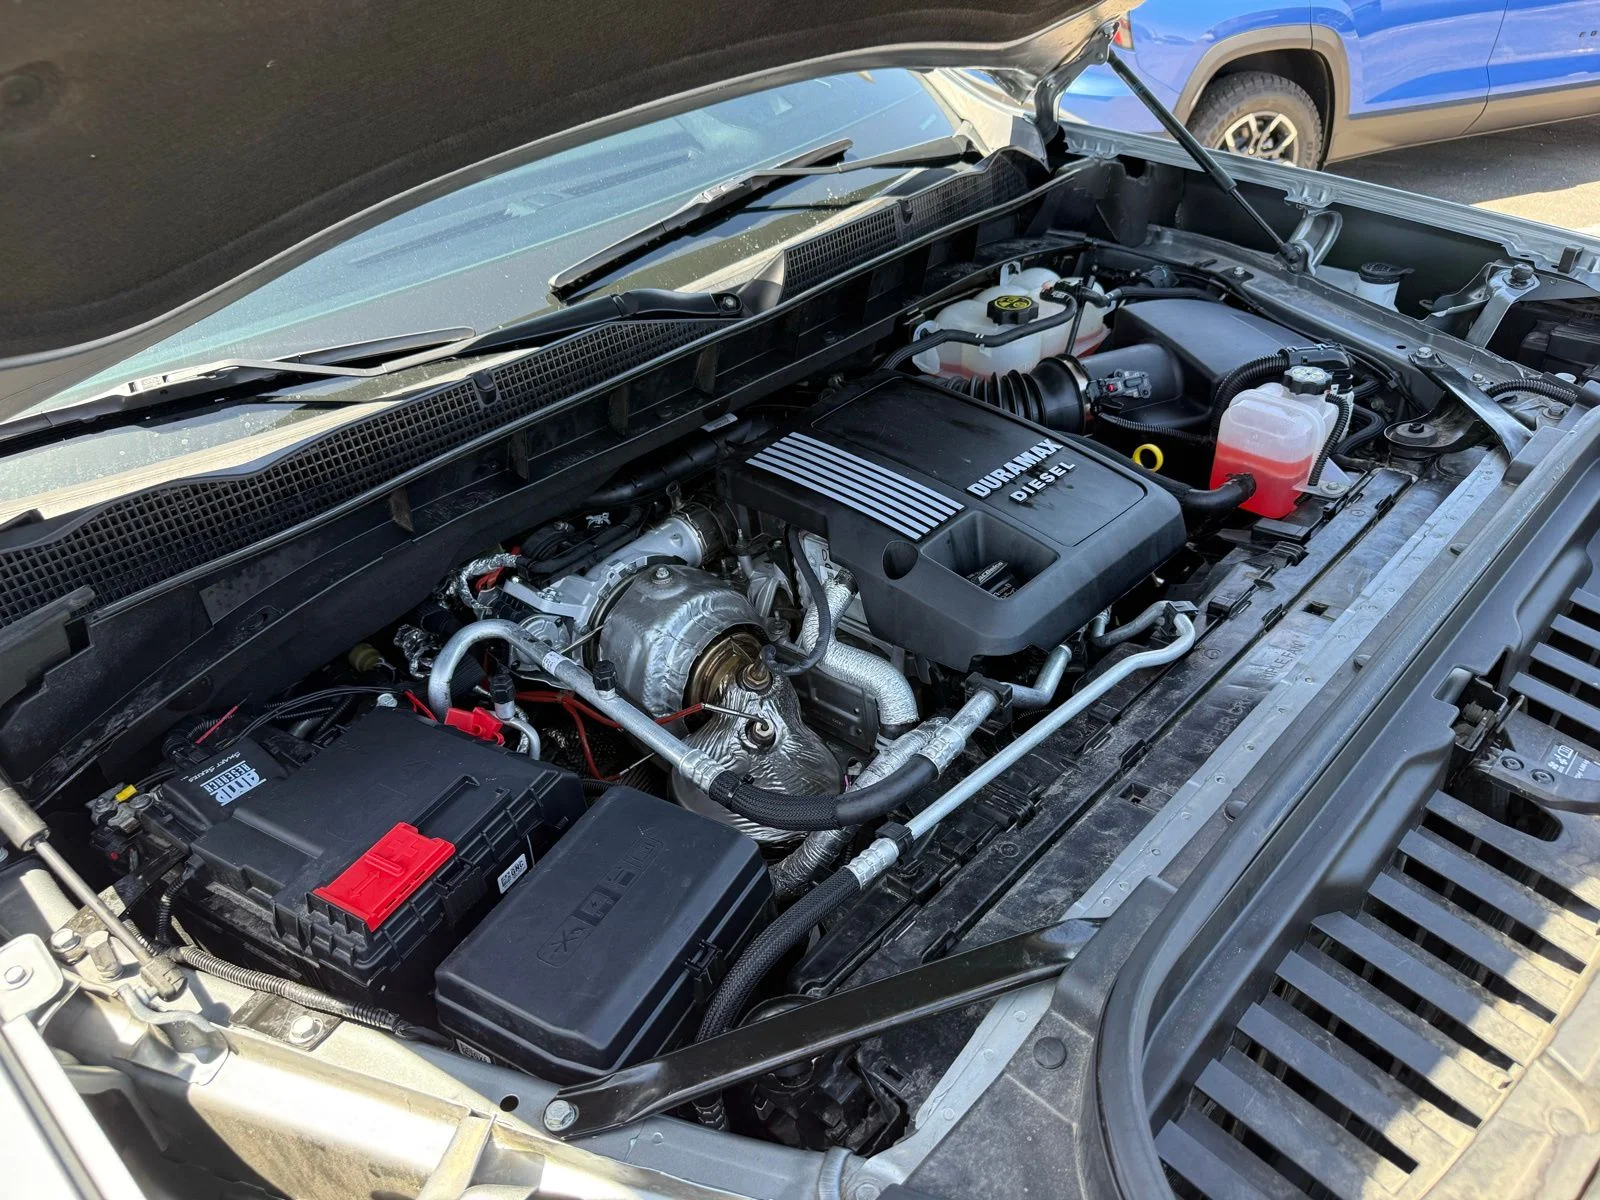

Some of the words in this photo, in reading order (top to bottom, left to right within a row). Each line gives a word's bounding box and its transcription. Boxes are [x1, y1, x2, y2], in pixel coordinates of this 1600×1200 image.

[966, 438, 1064, 498] DURAMAX
[1009, 462, 1076, 502] DIESEL
[203, 763, 251, 793] RESEARCH
